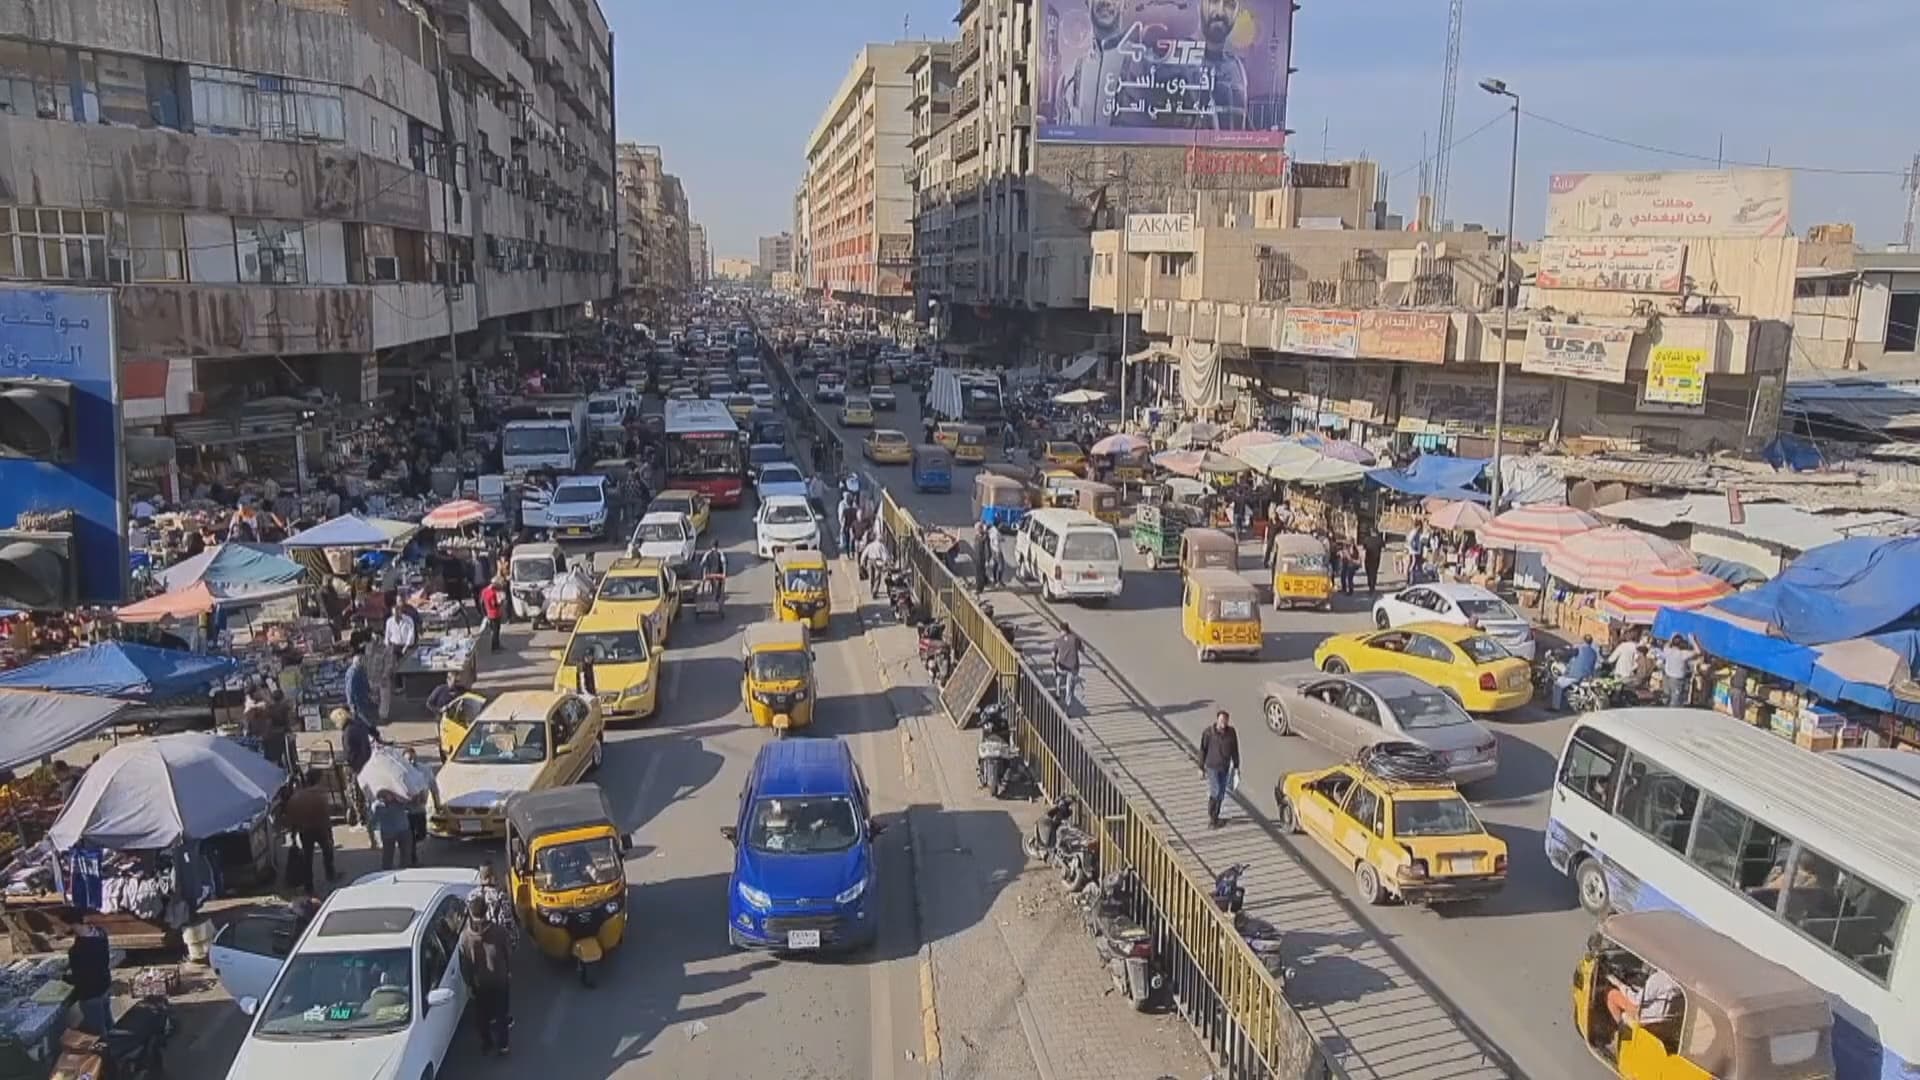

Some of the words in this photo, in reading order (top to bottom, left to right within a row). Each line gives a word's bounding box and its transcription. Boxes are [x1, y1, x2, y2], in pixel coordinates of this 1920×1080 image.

[1102, 98, 1146, 117] العراق
[1148, 98, 1173, 120] في
[1176, 98, 1217, 119] شبكة
[1544, 336, 1607, 356] USA
[330, 1007, 351, 1020] TAXI
